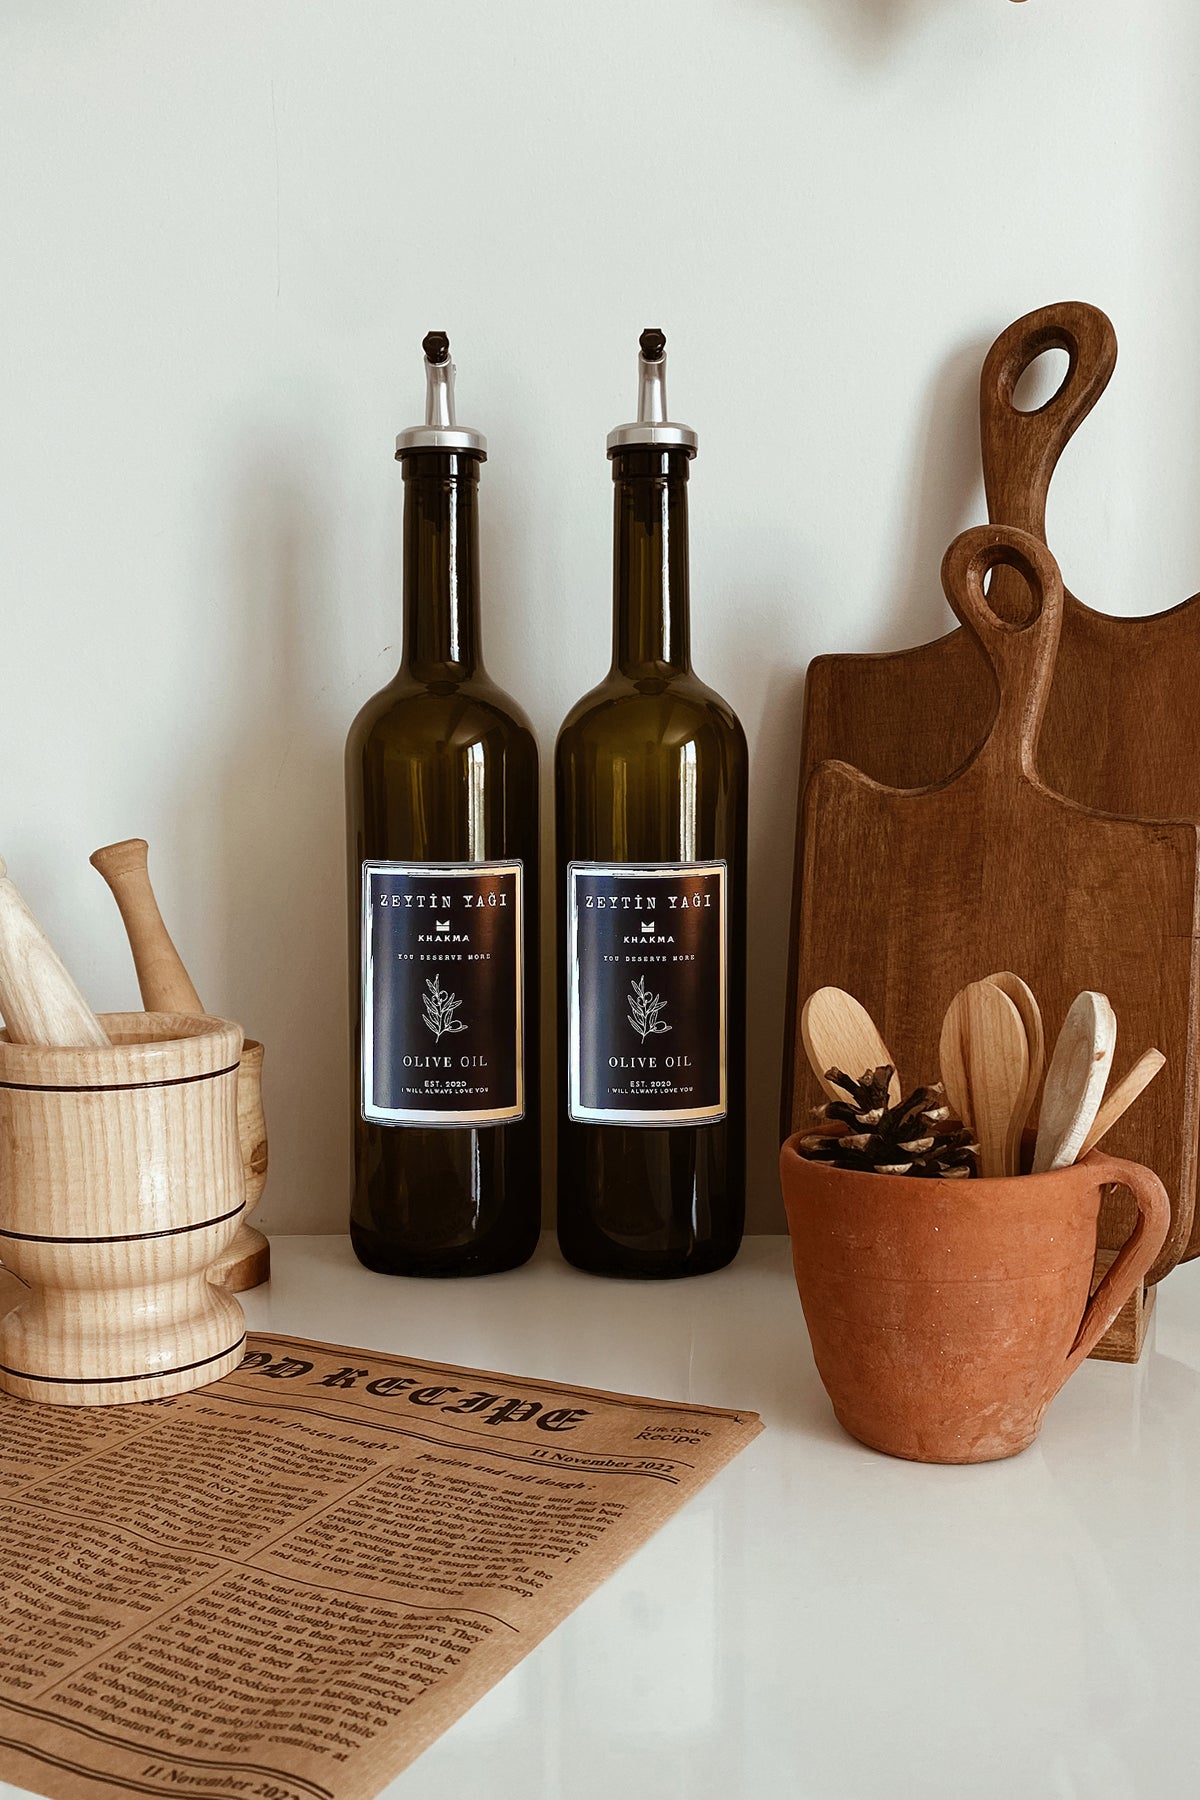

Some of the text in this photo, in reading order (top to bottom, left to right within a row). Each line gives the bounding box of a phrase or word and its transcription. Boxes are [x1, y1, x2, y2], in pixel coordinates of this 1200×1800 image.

[380, 891, 507, 908] ZEYTİN YAĞI
[585, 893, 711, 910] ZEYTİN YAĞI
[623, 936, 674, 944] KHAKMA
[403, 1055, 488, 1067] OLIVE OIL
[608, 1056, 691, 1068] OLIVE OIL
[307, 1368, 594, 1432] RECIPE
[195, 1407, 229, 1416] How
[249, 1415, 284, 1425] bake
[281, 1421, 336, 1439] frozen
[338, 1436, 399, 1451] dough?
[633, 1432, 701, 1444] Recipe
[283, 1440, 310, 1451] make
[310, 1449, 355, 1461] chocolate
[355, 1457, 377, 1466] chip
[529, 1449, 675, 1471] 11 November 2022
[415, 1452, 472, 1468] Portion
[473, 1465, 507, 1475] and
[504, 1473, 538, 1482] roll
[535, 1478, 585, 1489] dough
[420, 1478, 451, 1489] Then
[490, 1495, 540, 1508] chocolate
[542, 1503, 577, 1512] chips
[598, 1508, 623, 1517] beat
[133, 1520, 159, 1534] when
[16, 1520, 54, 1532] cookies
[83, 1536, 108, 1549] oven
[139, 1558, 191, 1575] beginning
[126, 1541, 159, 1556] frozen
[159, 1552, 197, 1565] dough)
[293, 1535, 333, 1549] cookies
[356, 1552, 399, 1566] uniform
[460, 1570, 483, 1578] that
[485, 1572, 512, 1581] they
[514, 1575, 543, 1588] bake
[321, 1565, 353, 1576] every
[353, 1571, 379, 1580] time
[386, 1579, 419, 1589] make
[329, 1554, 354, 1565] love
[355, 1562, 377, 1570] this
[378, 1568, 426, 1580] stainless
[499, 1585, 533, 1598] scoop
[211, 1589, 235, 1599] will
[232, 1595, 259, 1608] look
[266, 1606, 294, 1618] little
[293, 1614, 338, 1630] doughy
[338, 1625, 369, 1635] when
[439, 1639, 471, 1653] them
[222, 1581, 247, 1592] chip
[247, 1589, 290, 1605] cookies
[290, 1601, 322, 1613] won't
[320, 1607, 349, 1619] look
[348, 1614, 378, 1625] done
[398, 1622, 426, 1632] they
[451, 1628, 482, 1644] They
[402, 1613, 433, 1621] these
[435, 1615, 493, 1632] chocolate
[141, 1765, 163, 1778] 11
[163, 1769, 253, 1790] November
